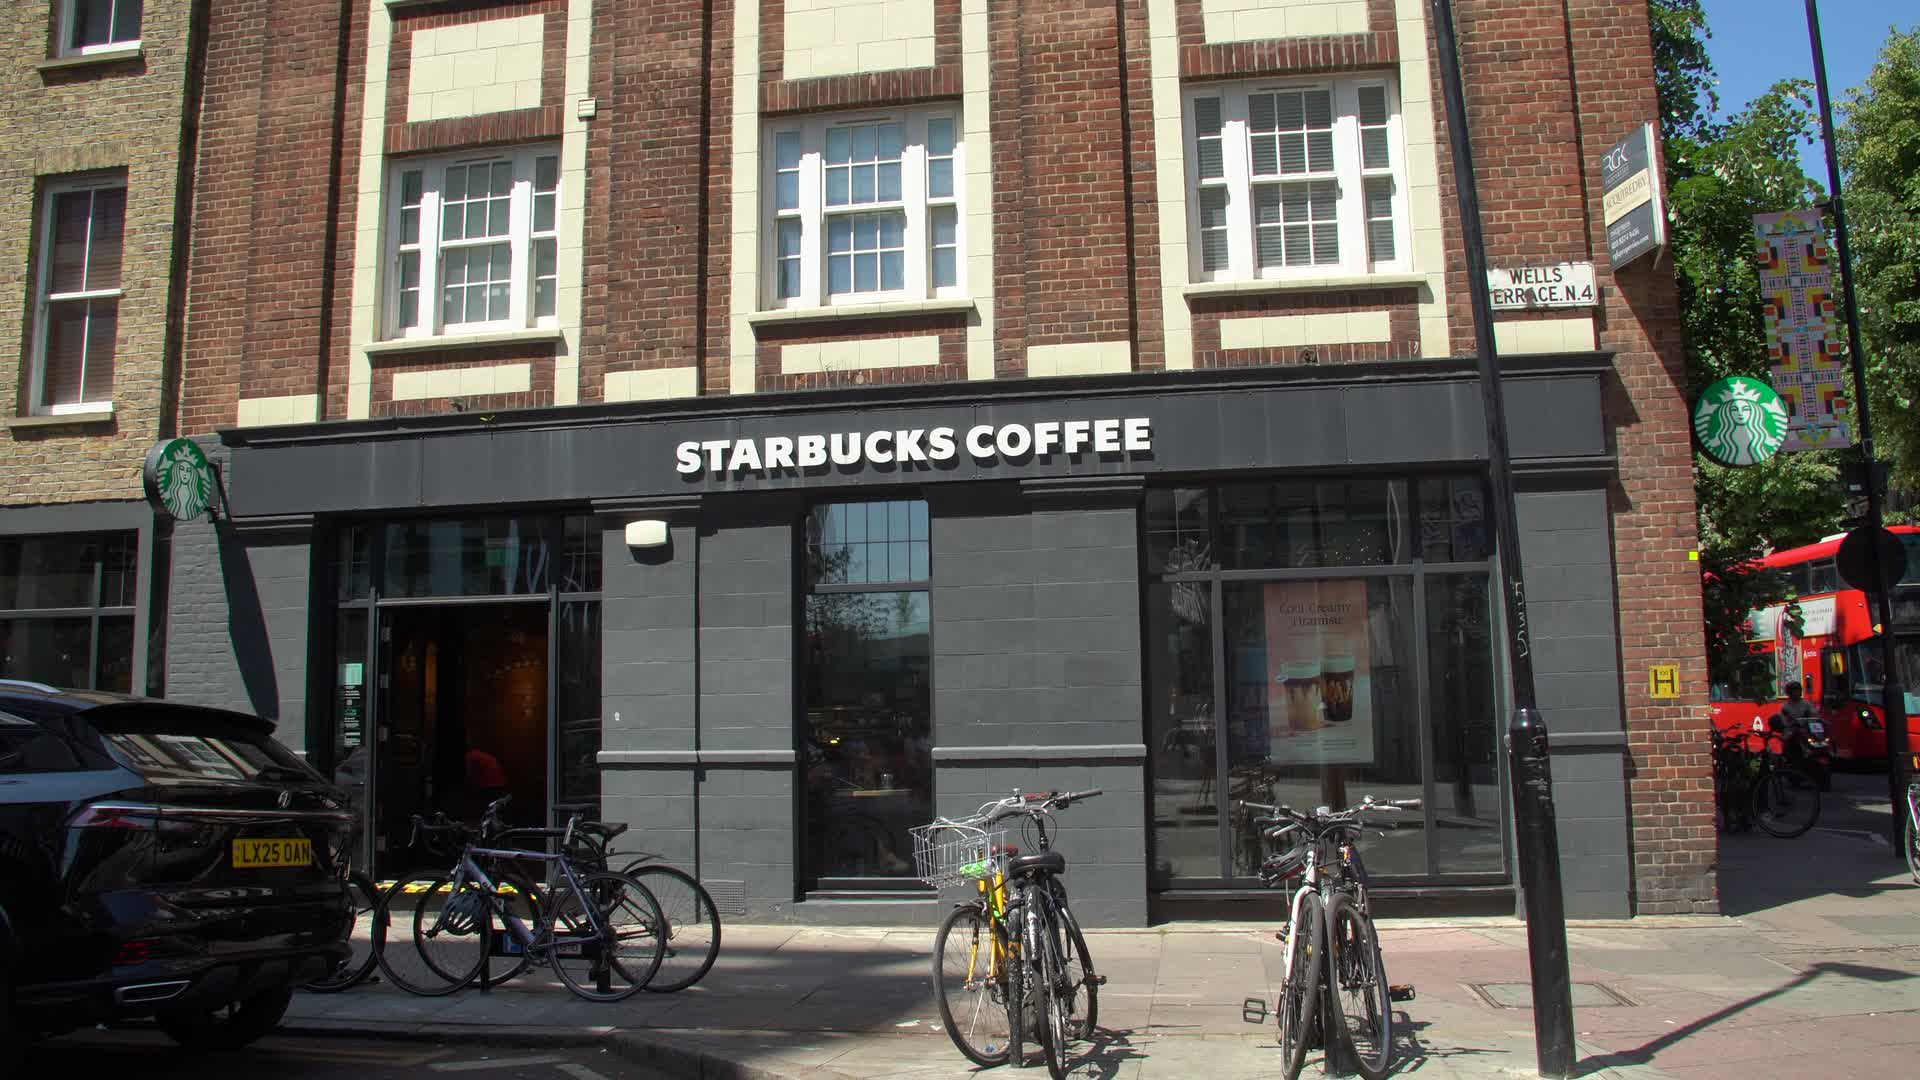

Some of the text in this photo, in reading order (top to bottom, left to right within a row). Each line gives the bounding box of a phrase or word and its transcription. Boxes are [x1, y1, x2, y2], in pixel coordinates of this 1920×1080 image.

[1603, 143, 1629, 171] RGK
[1509, 268, 1563, 285] WELLS
[1492, 286, 1563, 304] ERRACE.
[676, 417, 1152, 474] STARBUCKS COFFEE
[1653, 668, 1675, 695] H
[242, 843, 280, 864] LX25
